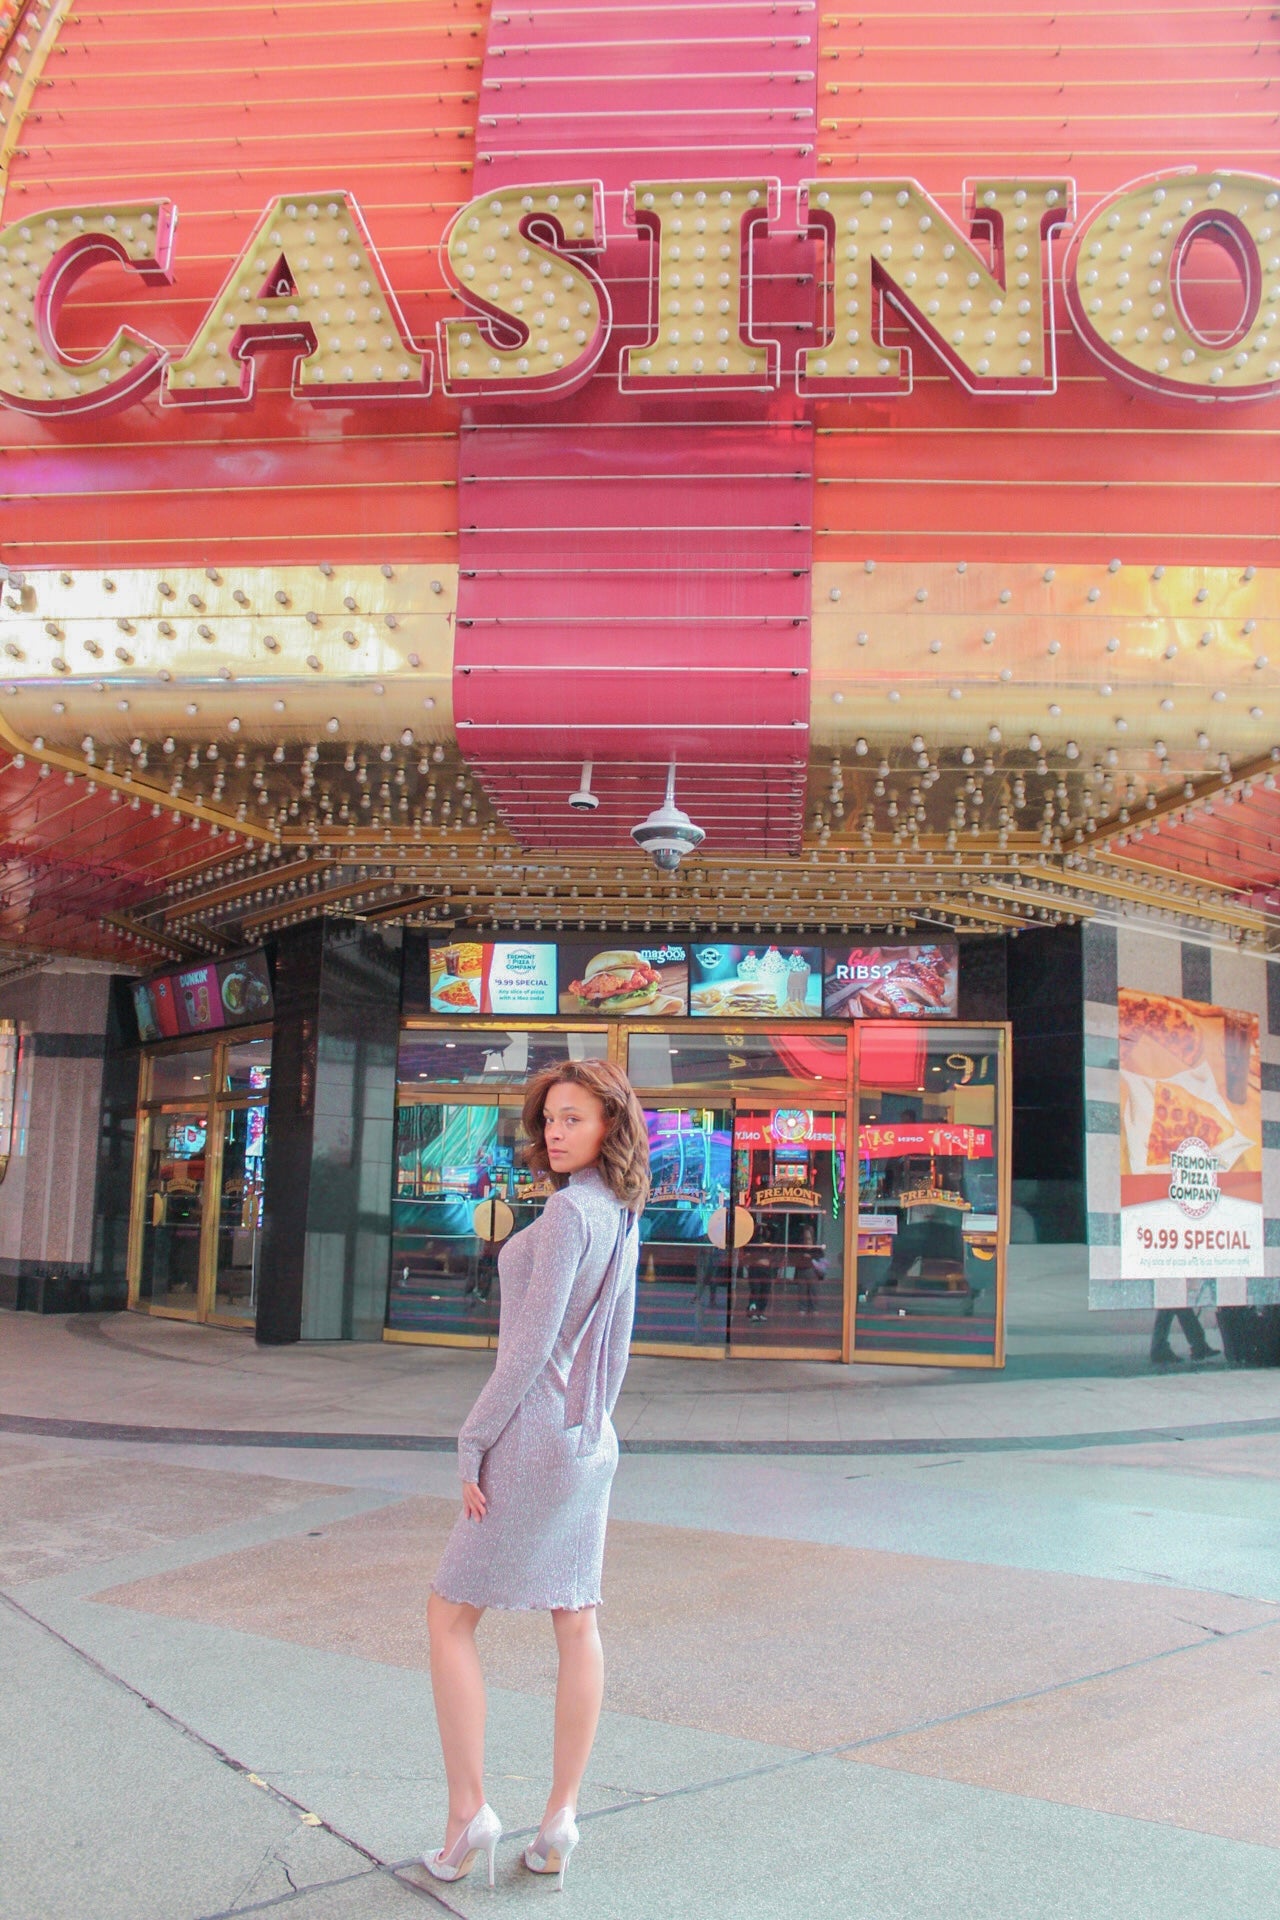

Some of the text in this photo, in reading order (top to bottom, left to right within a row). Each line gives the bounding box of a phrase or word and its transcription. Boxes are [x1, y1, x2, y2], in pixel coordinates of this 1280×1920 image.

[0, 167, 1280, 416] CASINO
[836, 964, 892, 980] RIBS?
[1171, 1153, 1218, 1171] FREMONT
[1180, 1170, 1209, 1186] PIZZA
[755, 1187, 822, 1206] FREMONT
[1169, 1185, 1220, 1202] COMPANY
[1137, 1227, 1251, 1250] $9.99 SPECIAL
